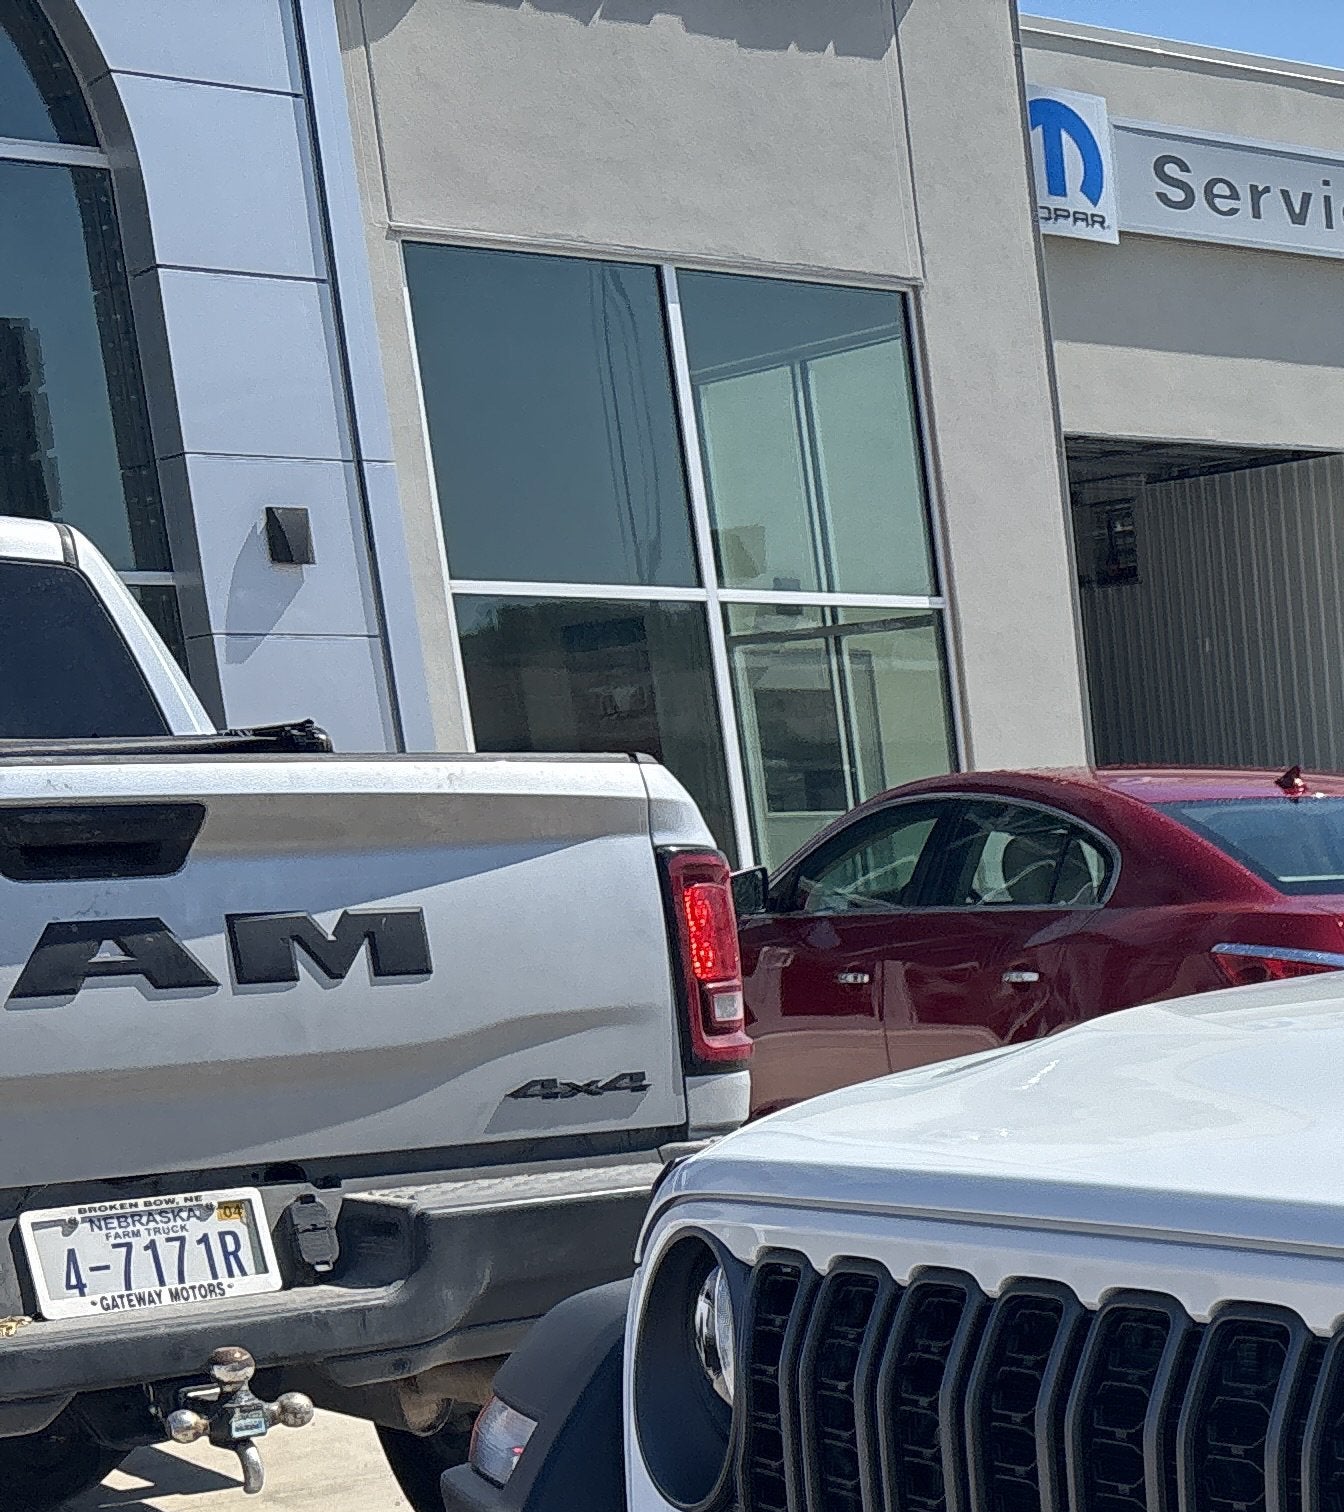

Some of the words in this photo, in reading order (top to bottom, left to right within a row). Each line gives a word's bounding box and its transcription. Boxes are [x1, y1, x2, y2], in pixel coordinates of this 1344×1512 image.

[1037, 205, 1106, 230] OPAR
[6, 906, 433, 1000] AM
[77, 1200, 139, 1215] BROKEN
[184, 1194, 203, 1204] NE
[89, 1206, 201, 1233] NEBRASKA
[105, 1228, 141, 1241] FARM
[145, 1223, 189, 1236] TRUCK
[65, 1230, 248, 1297] 4-7171R
[100, 1289, 163, 1312] GATEWAY
[168, 1281, 226, 1302] MOTORS
